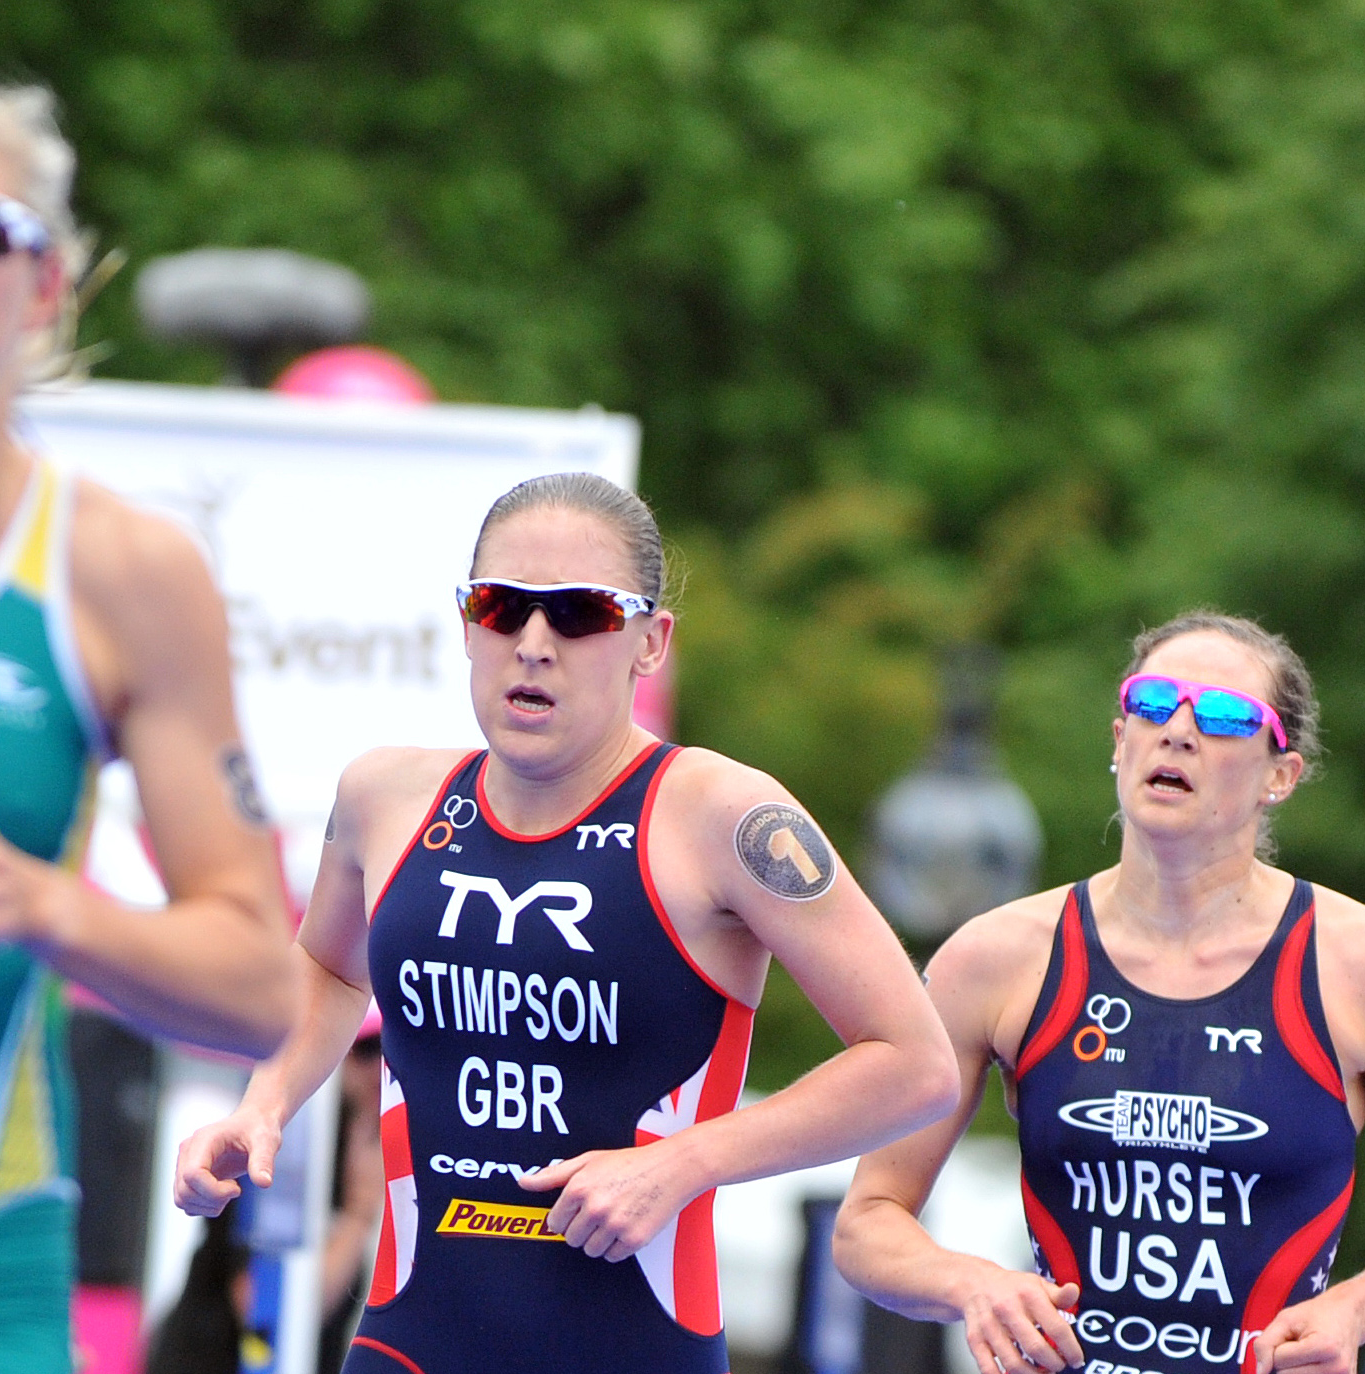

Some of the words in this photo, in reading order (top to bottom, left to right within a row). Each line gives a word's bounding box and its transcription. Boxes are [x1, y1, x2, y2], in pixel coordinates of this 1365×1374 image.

[576, 822, 635, 850] TYR
[767, 826, 822, 884] 1
[438, 869, 595, 953] TYR
[398, 958, 619, 1045] STIMPSON
[1104, 1047, 1126, 1063] ITU
[1204, 1025, 1263, 1055] TYR
[457, 1055, 570, 1135] GBR
[1116, 1094, 1131, 1137] TEAM
[1129, 1095, 1208, 1144] PSYCHO
[429, 1153, 567, 1183] cerv
[1117, 1140, 1208, 1154] TRIATHLETE
[1063, 1159, 1262, 1227] HURSEY
[1089, 1225, 1235, 1305] USA
[1076, 1308, 1265, 1366] coeur
